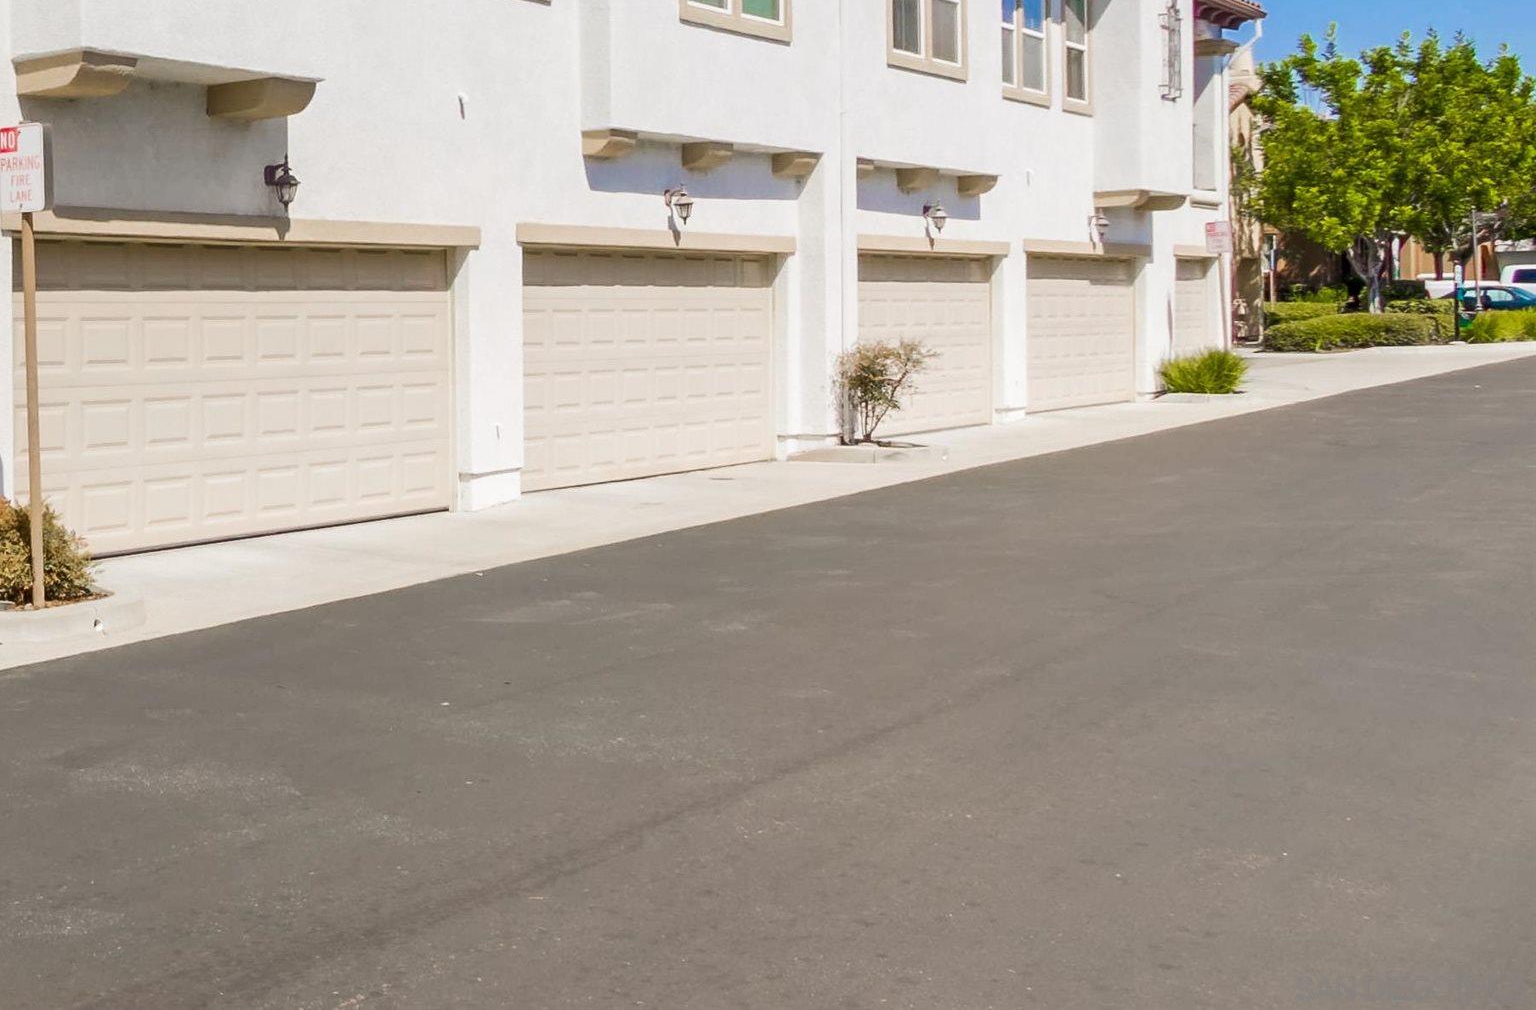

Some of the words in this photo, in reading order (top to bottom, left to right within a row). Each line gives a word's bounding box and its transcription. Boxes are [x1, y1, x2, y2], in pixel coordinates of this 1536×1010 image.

[0, 131, 16, 150] NO
[0, 156, 41, 172] PARKING
[10, 174, 32, 187] FIRE
[10, 190, 33, 204] LANE
